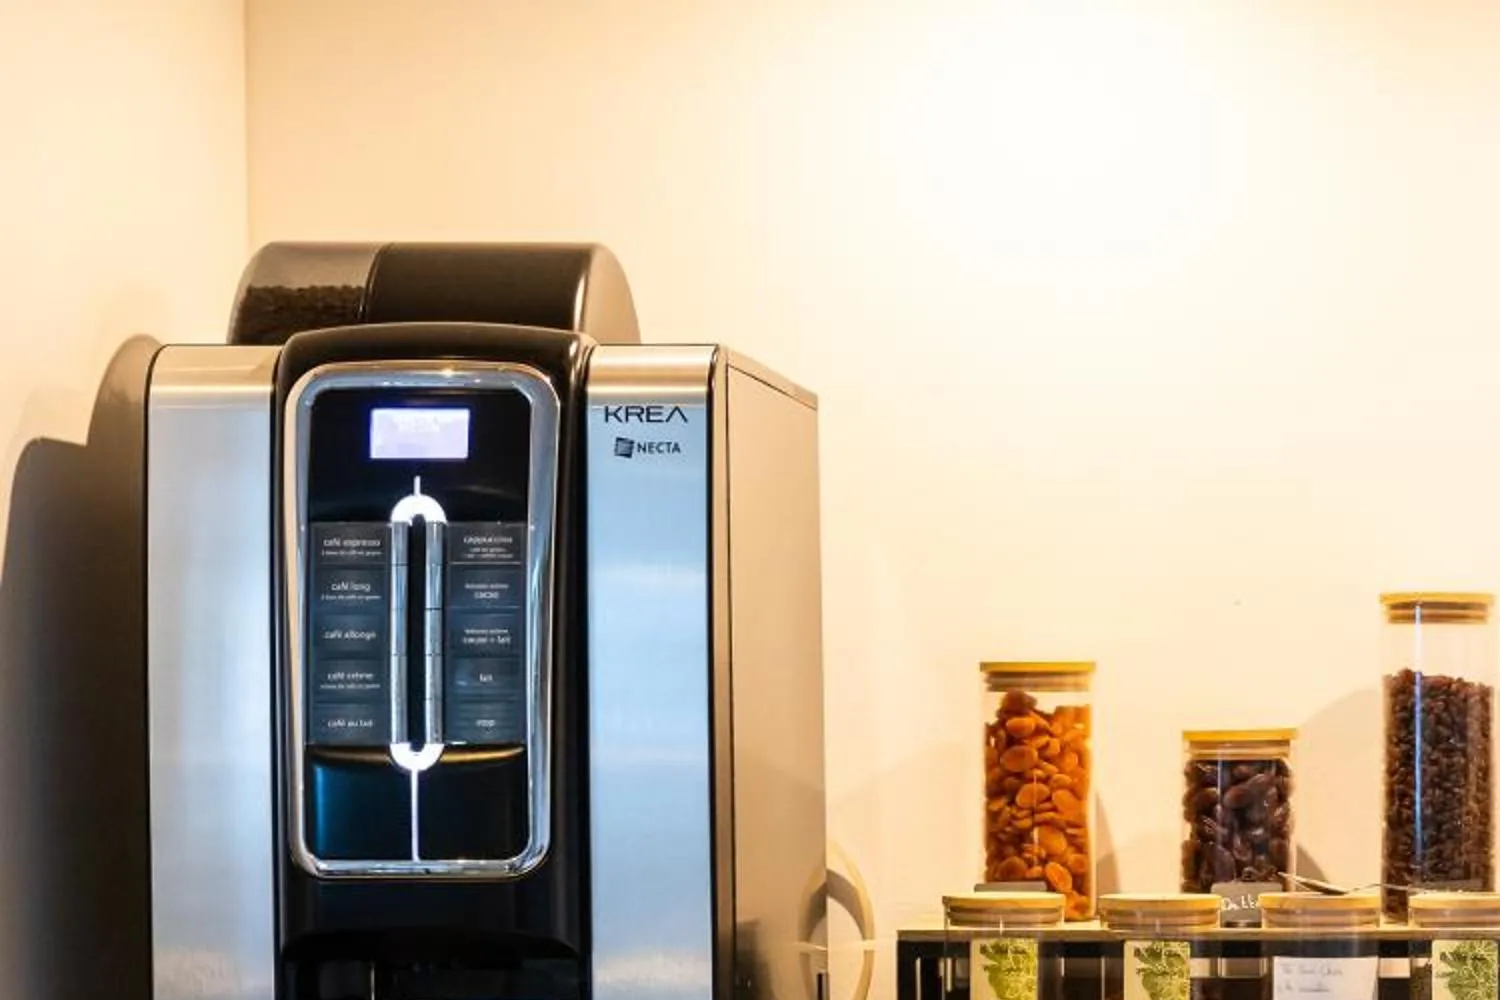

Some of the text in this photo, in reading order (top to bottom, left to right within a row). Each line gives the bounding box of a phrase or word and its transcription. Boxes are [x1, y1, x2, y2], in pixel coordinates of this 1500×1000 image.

[604, 406, 688, 423] KREA
[637, 442, 681, 454] NECTA
[323, 538, 340, 547] café
[331, 581, 348, 591] café
